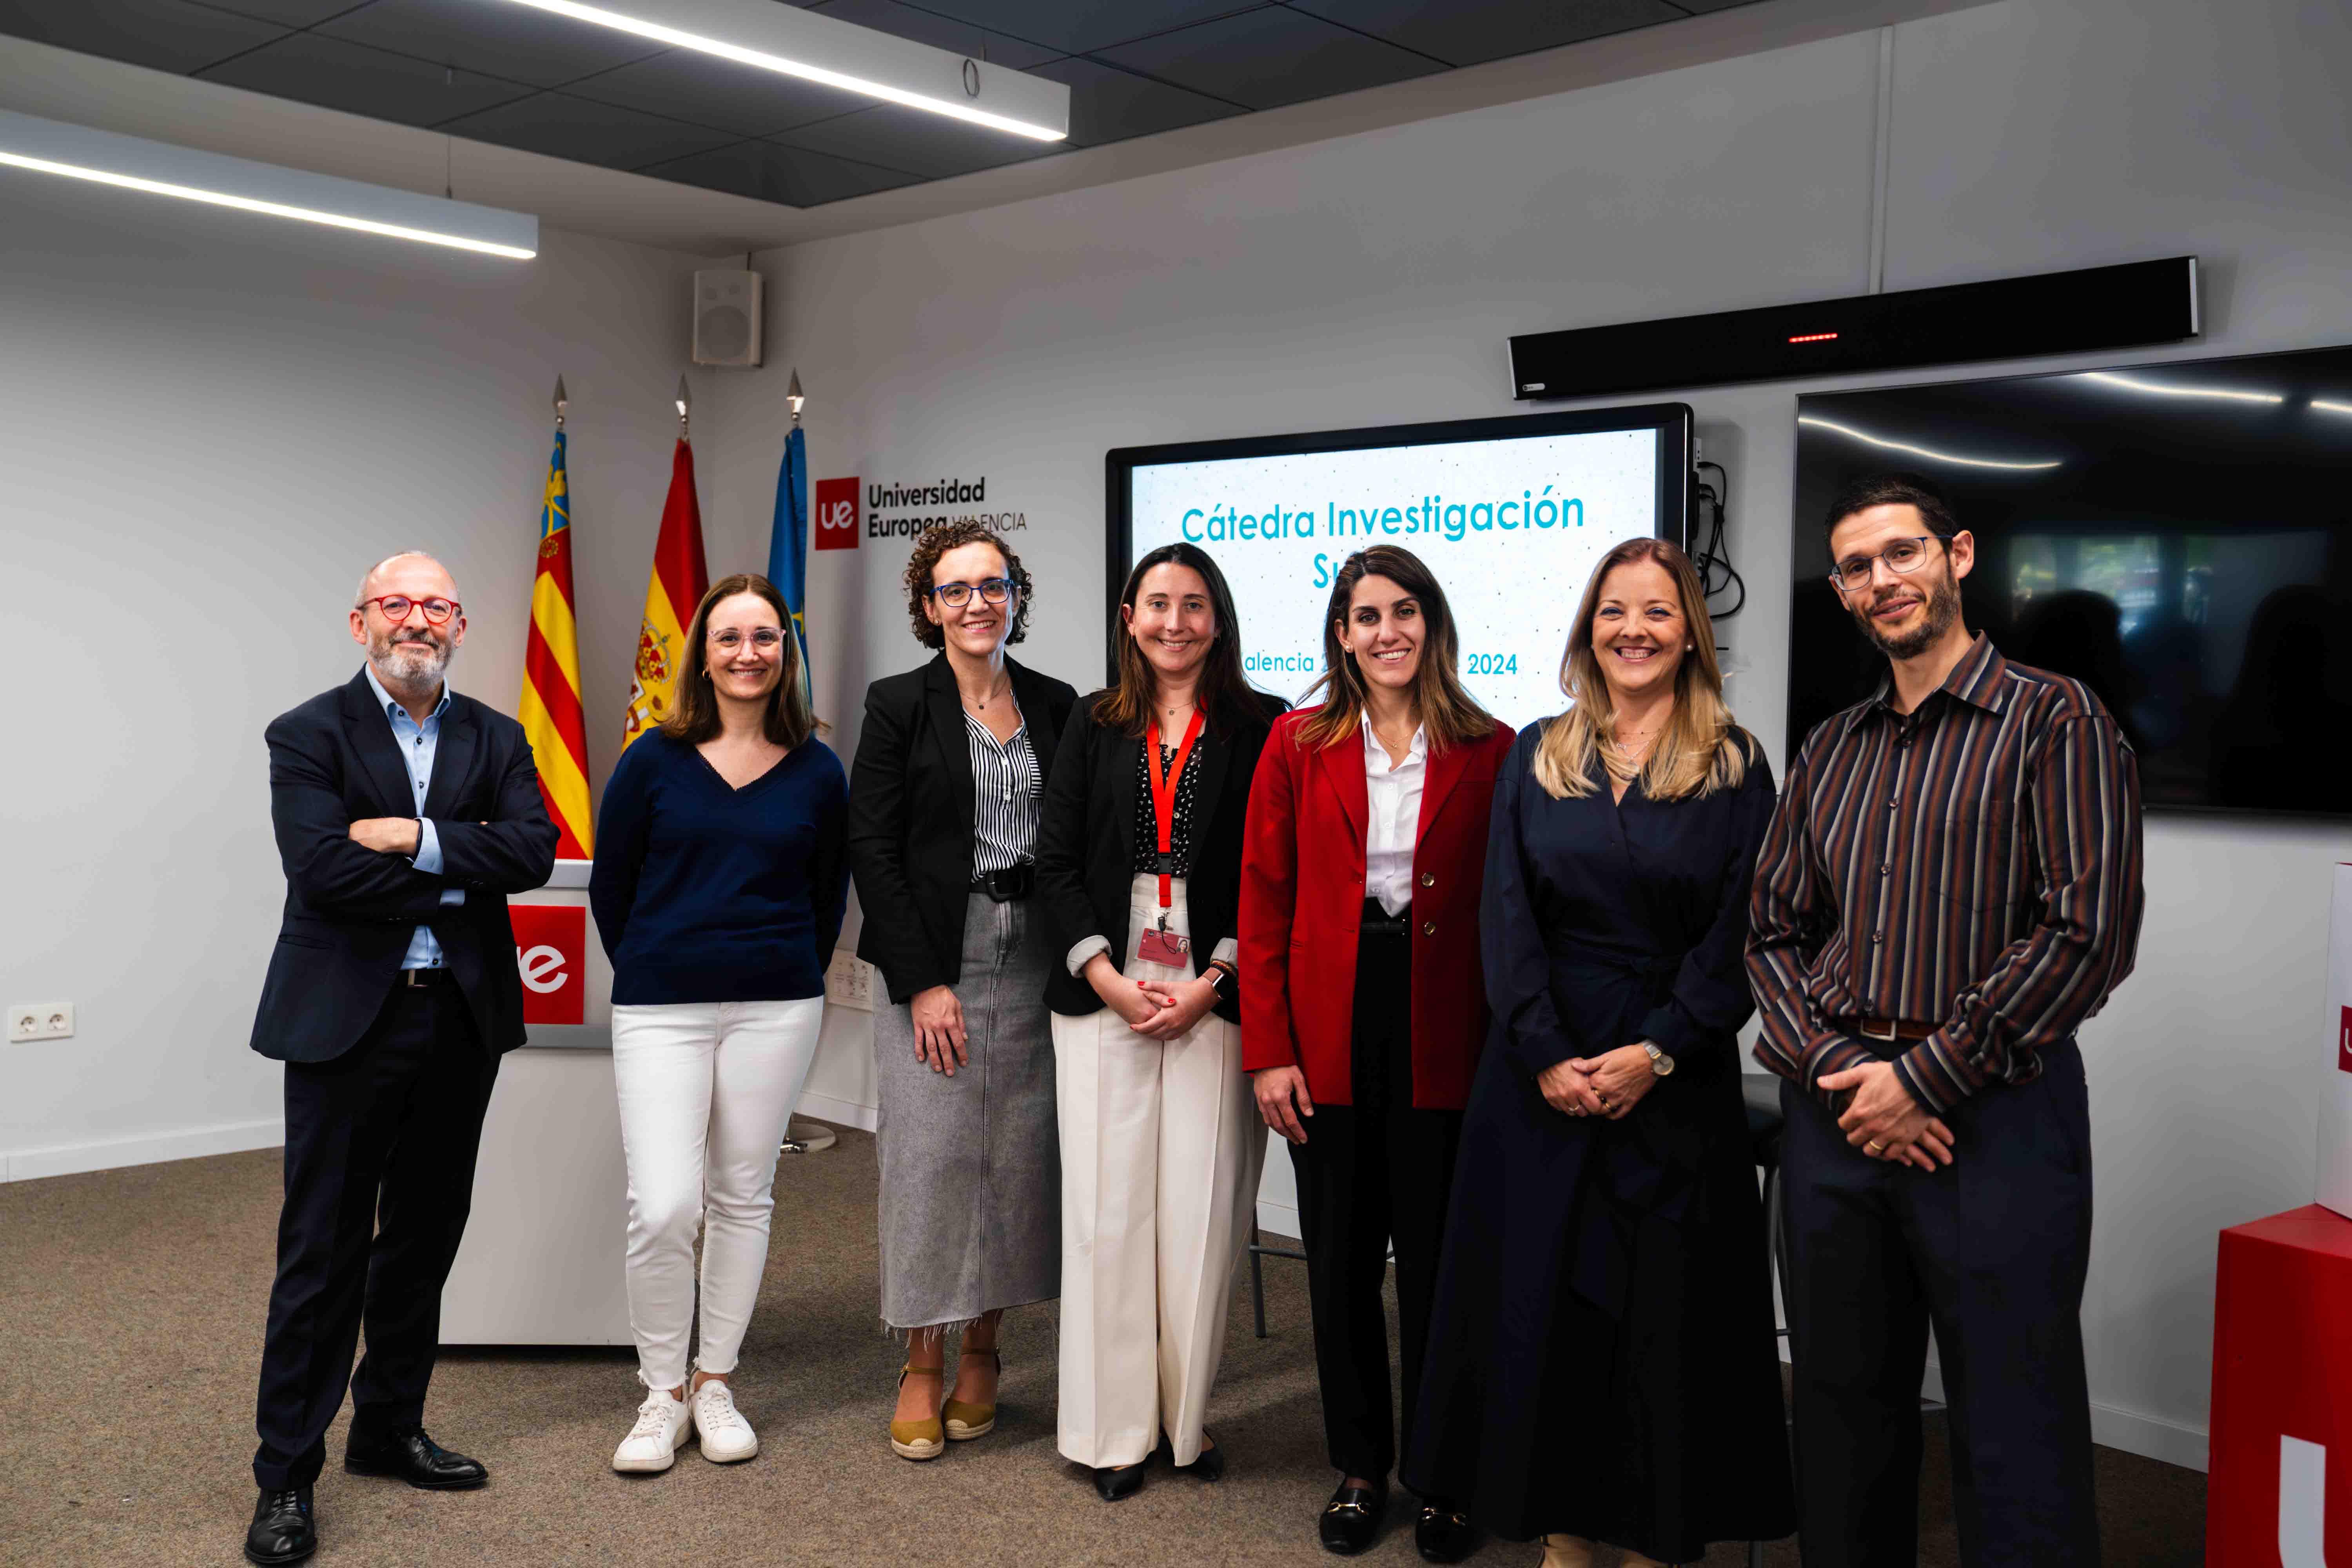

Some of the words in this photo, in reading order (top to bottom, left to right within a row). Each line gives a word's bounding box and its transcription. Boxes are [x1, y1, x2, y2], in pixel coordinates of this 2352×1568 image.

[869, 476, 985, 508] Universidad
[821, 500, 854, 530] ue
[869, 514, 947, 541] Europea
[1182, 503, 1314, 542] Cátedra
[1329, 485, 1583, 542] Investigación
[1245, 652, 1313, 671] alencia
[1467, 653, 1517, 674] 2024
[516, 945, 568, 993] e
